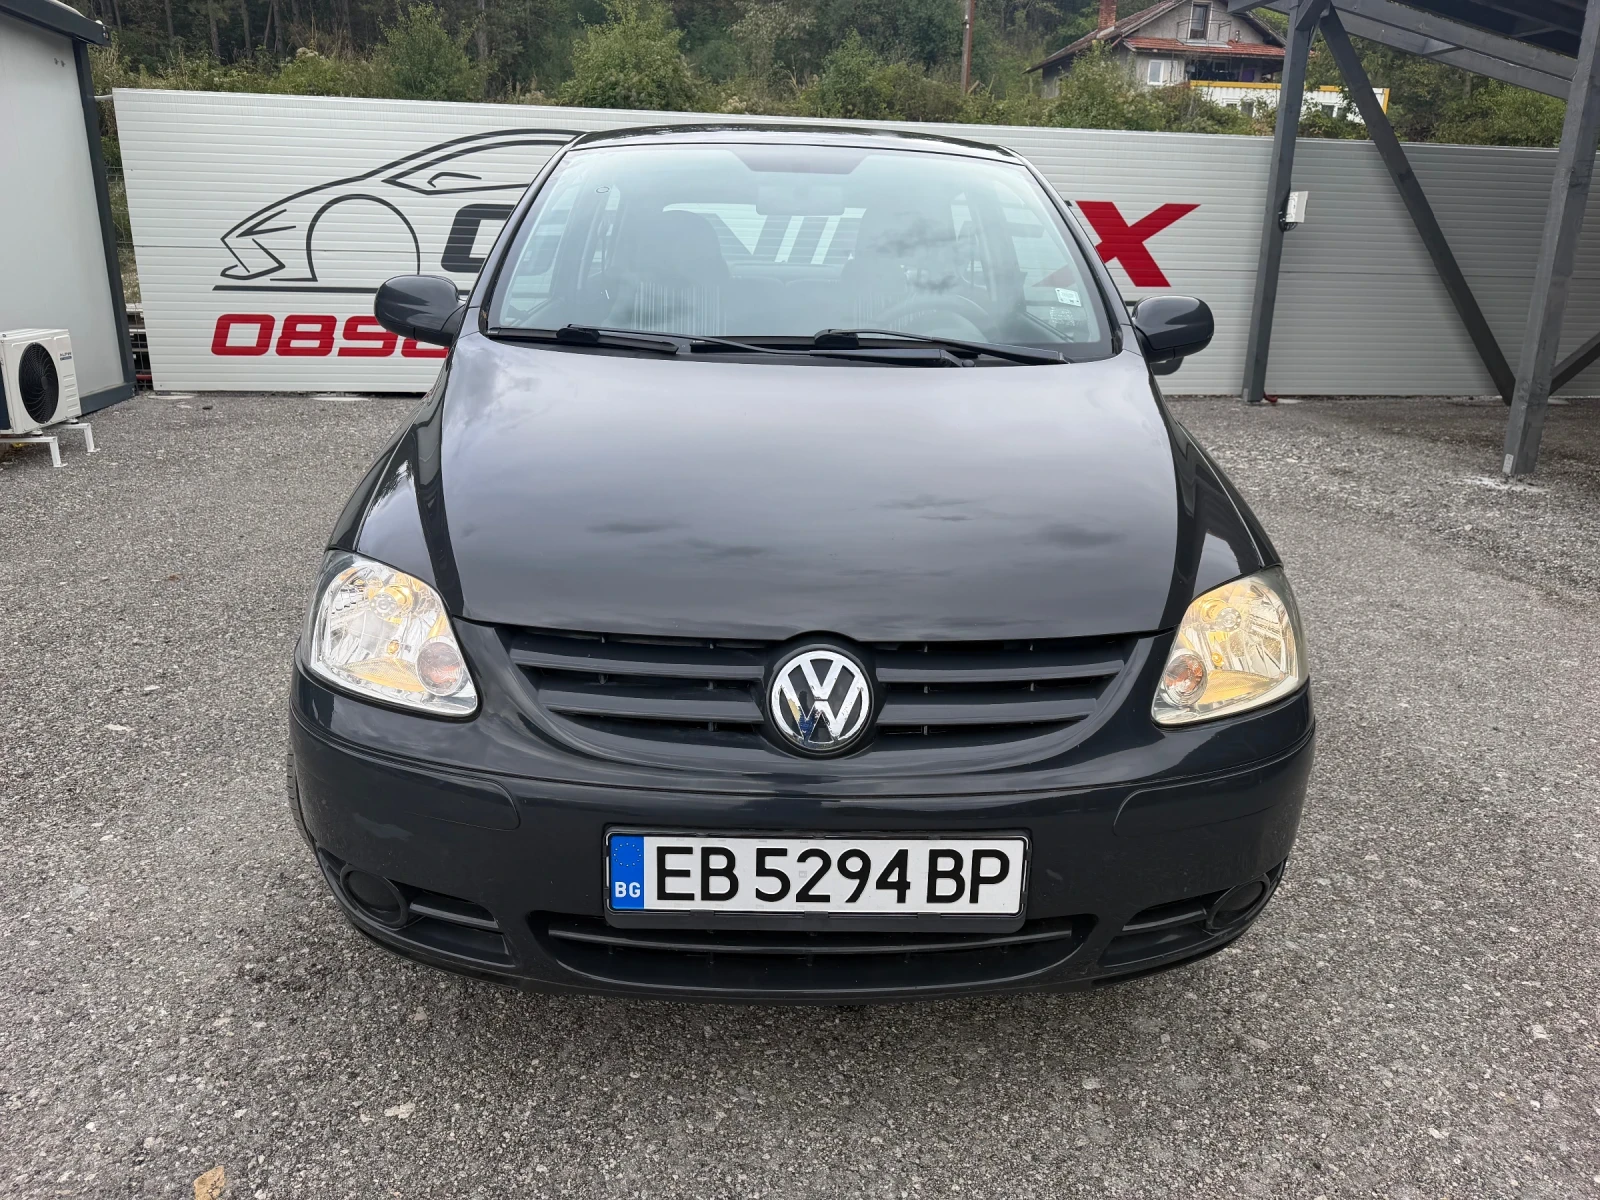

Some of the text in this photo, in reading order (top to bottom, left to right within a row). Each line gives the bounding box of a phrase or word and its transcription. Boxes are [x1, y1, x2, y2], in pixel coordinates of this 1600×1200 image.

[771, 650, 869, 750] VW
[614, 881, 641, 899] BG
[656, 846, 1010, 904] EB 5294 BP
